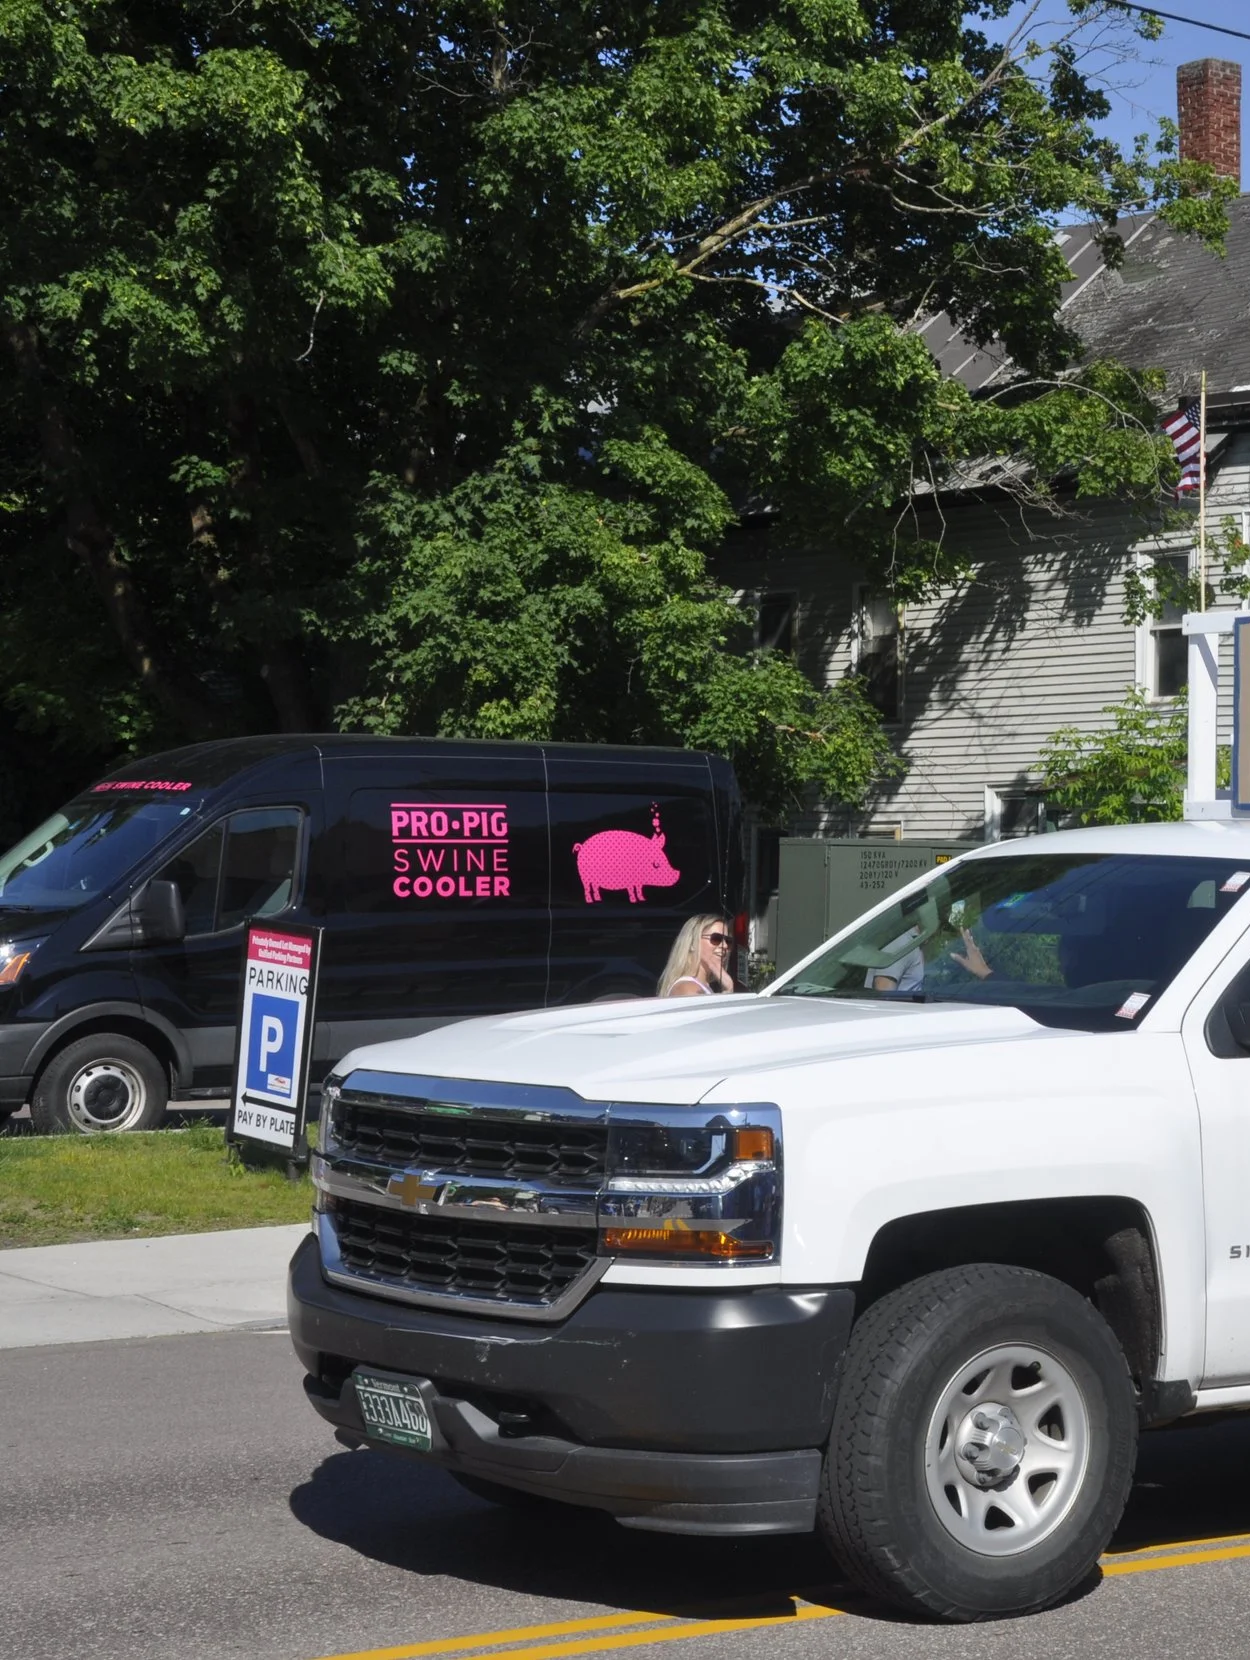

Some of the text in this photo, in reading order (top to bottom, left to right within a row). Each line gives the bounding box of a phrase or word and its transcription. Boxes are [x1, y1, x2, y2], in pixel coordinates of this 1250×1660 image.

[112, 781, 145, 790] SWINE
[143, 781, 192, 791] COOLER
[393, 848, 508, 872] SWINE
[393, 876, 510, 898] COOLER
[248, 967, 309, 996] PARKING
[237, 1108, 296, 1136] PAY BY PLATE
[371, 1377, 401, 1393] Vermont
